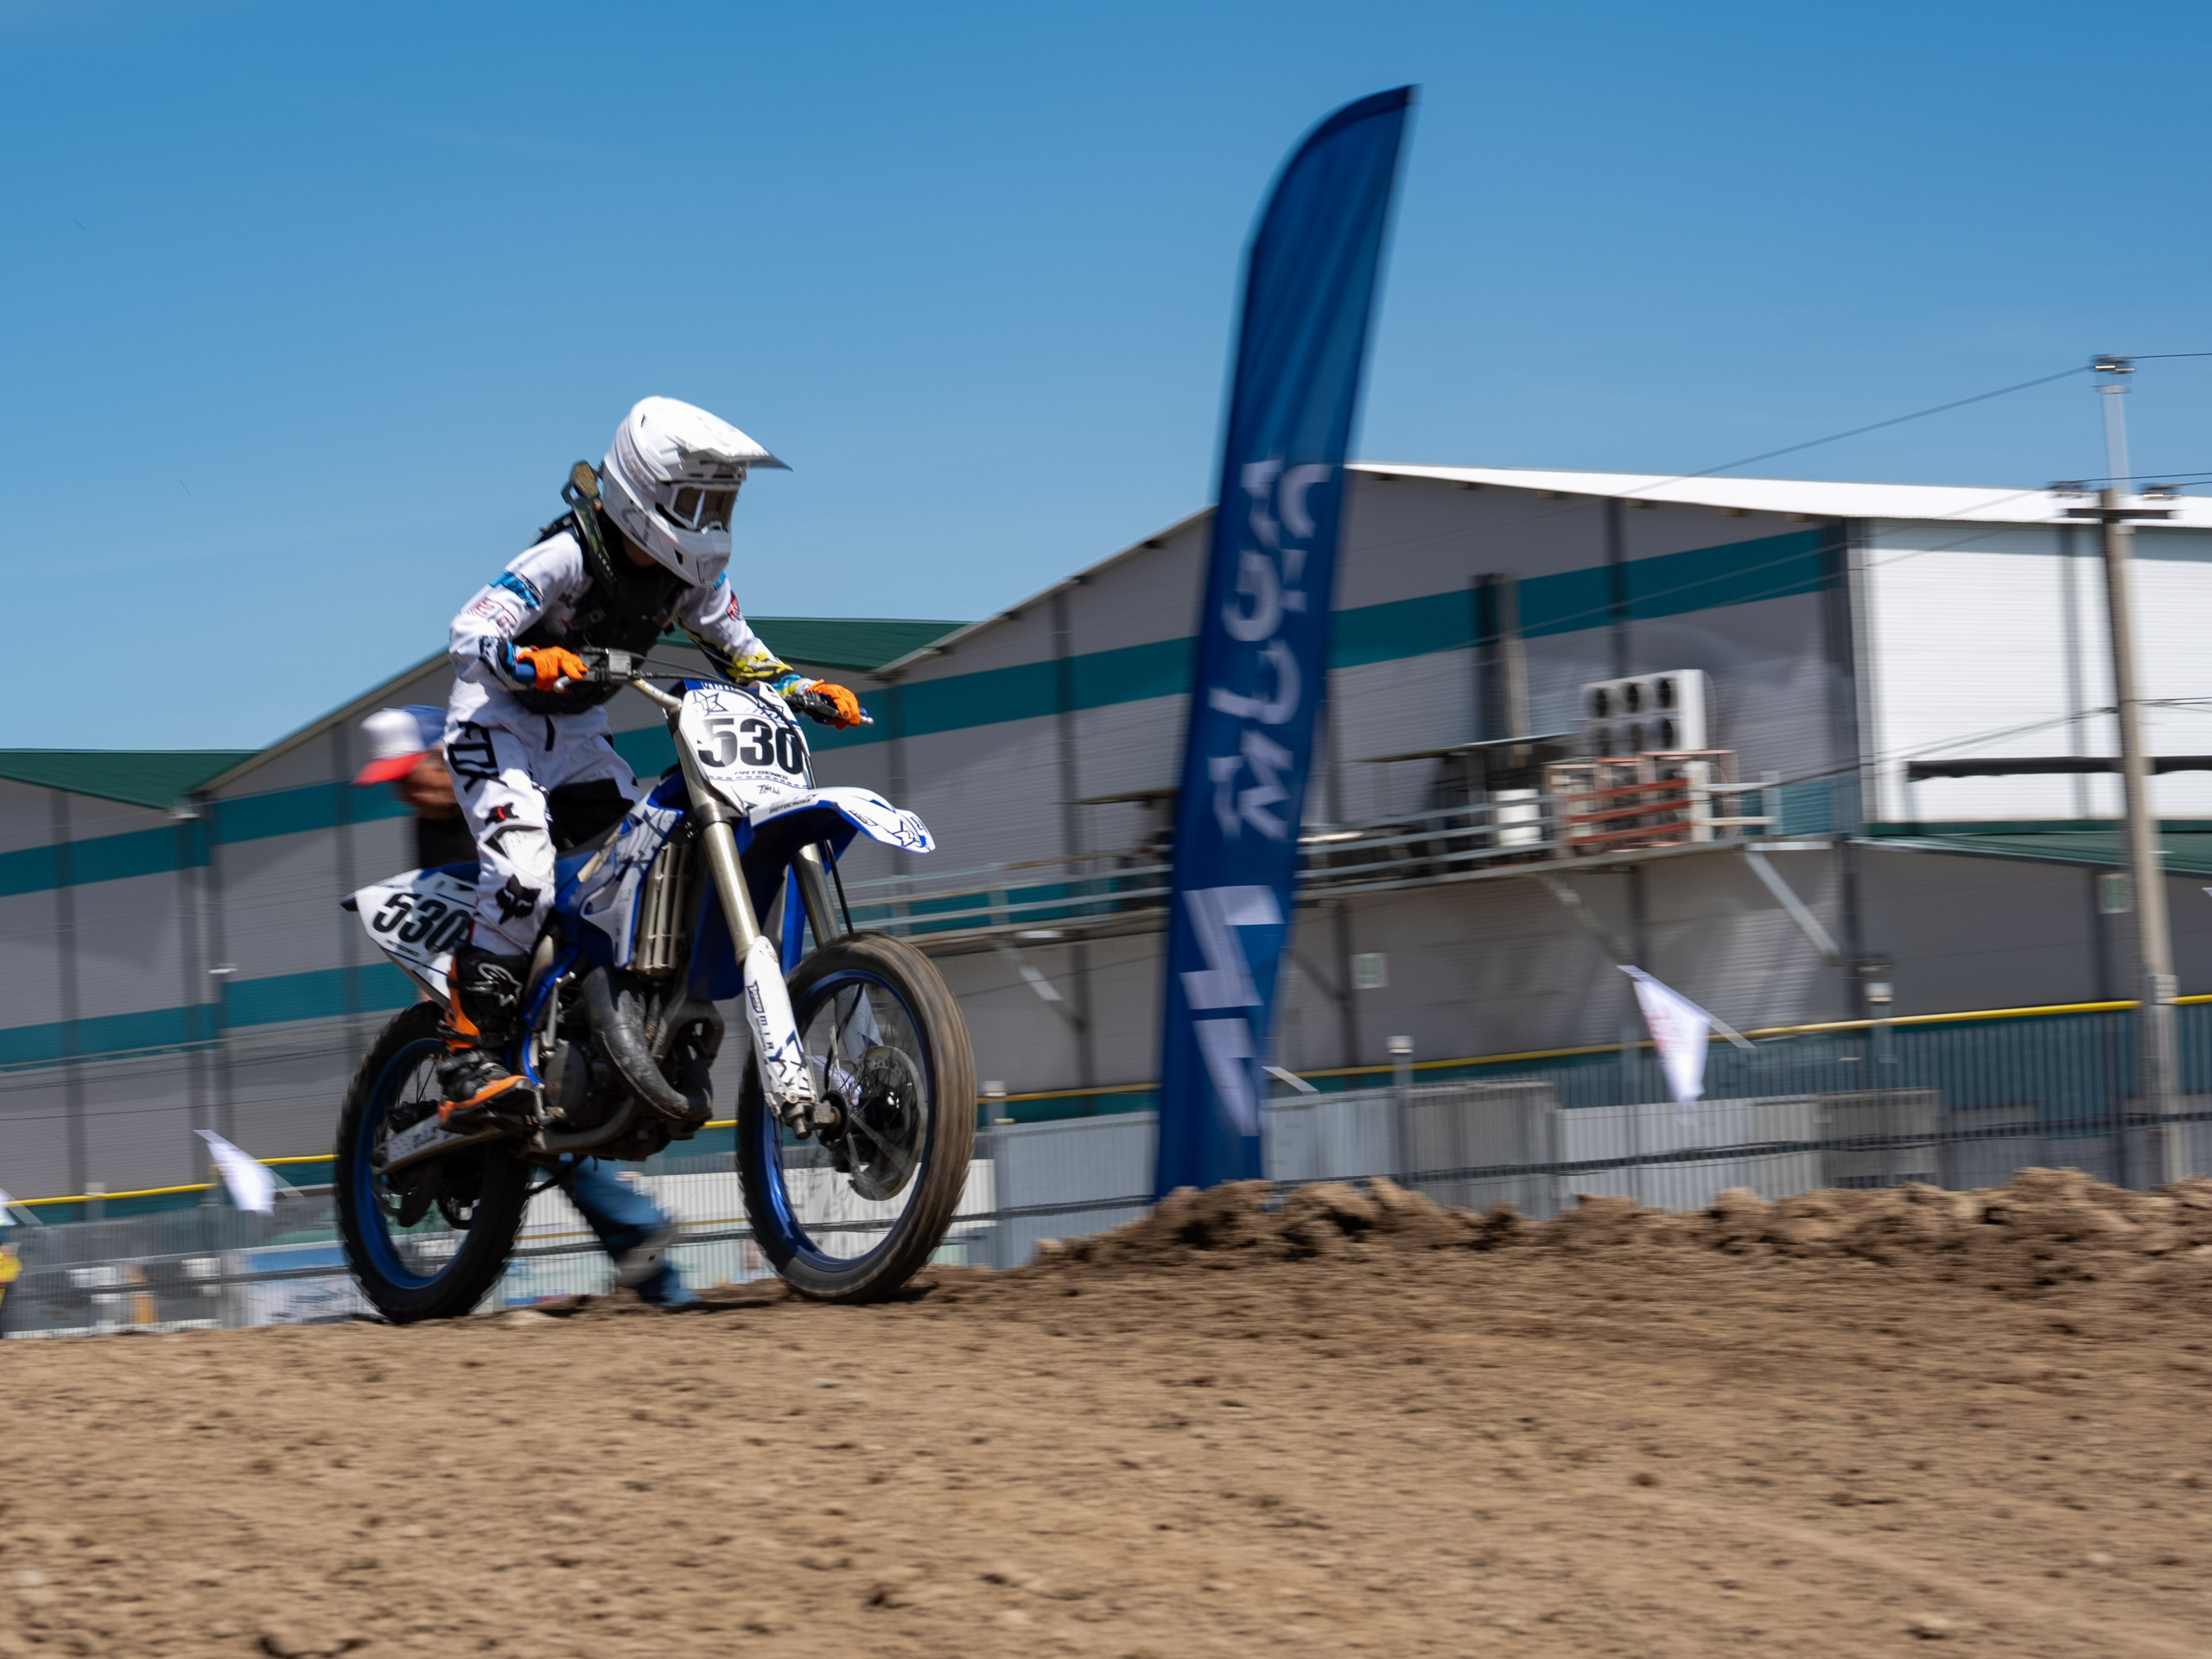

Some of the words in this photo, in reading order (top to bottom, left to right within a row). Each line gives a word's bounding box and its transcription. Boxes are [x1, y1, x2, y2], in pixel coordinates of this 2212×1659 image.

[448, 721, 509, 794] FOX
[697, 718, 804, 775] 530
[372, 892, 472, 954] 530
